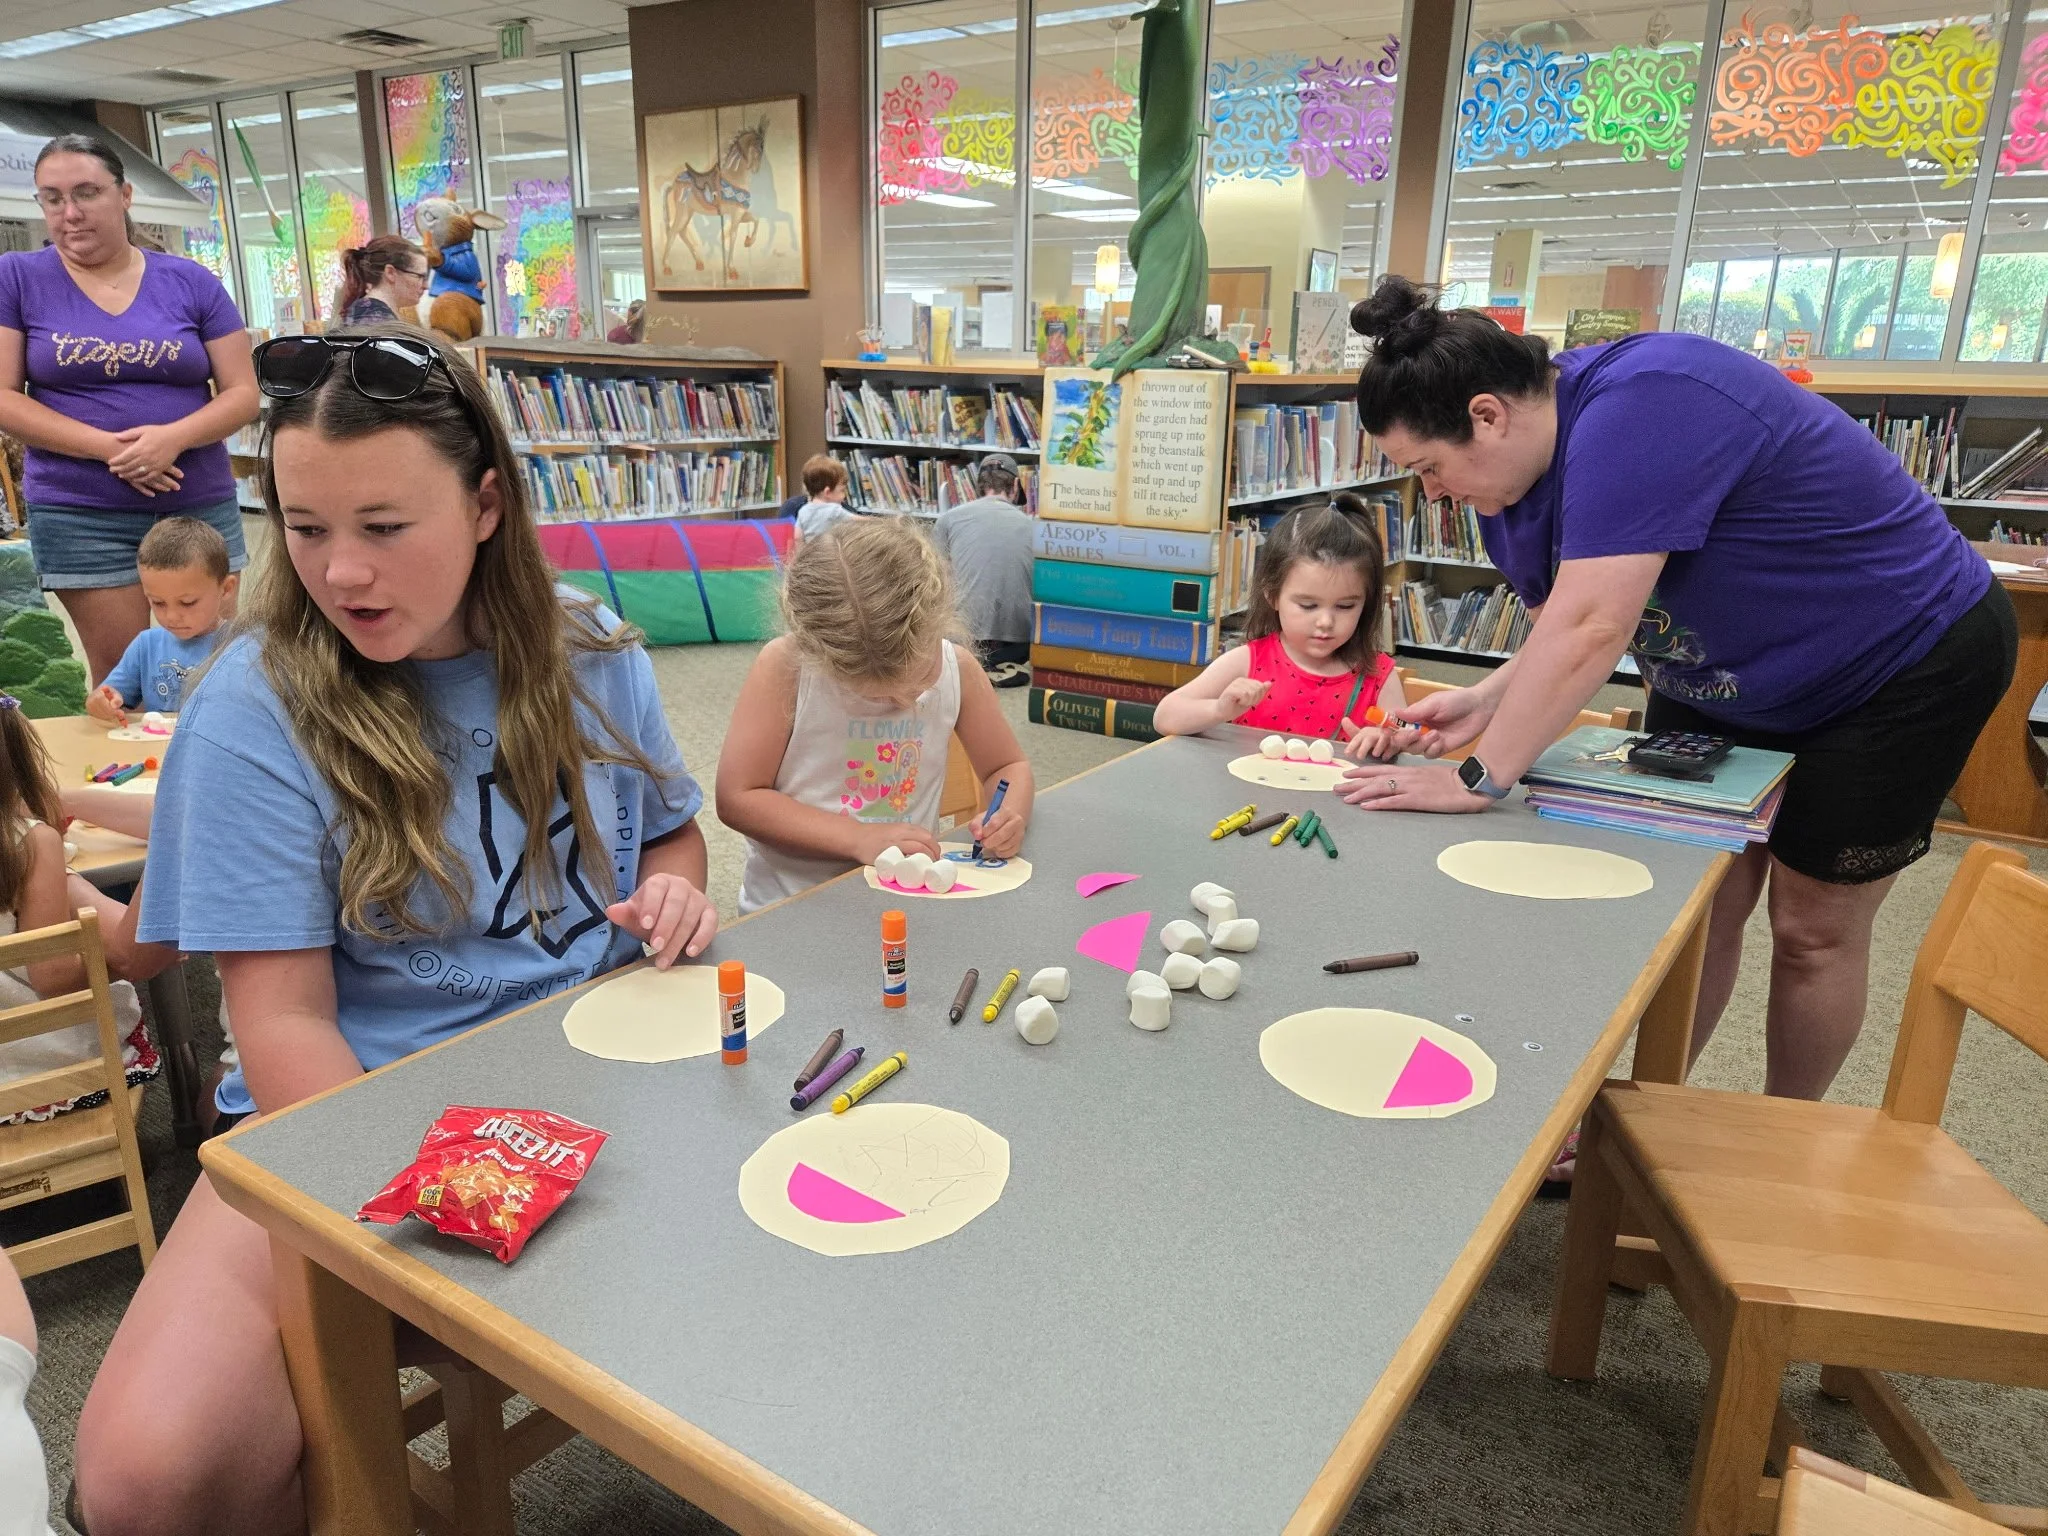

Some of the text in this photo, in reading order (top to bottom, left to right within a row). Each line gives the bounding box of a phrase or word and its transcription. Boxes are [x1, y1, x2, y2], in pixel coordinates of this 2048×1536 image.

[502, 26, 524, 59] EXIT
[1141, 381, 1208, 393] thrown out of
[1133, 397, 1212, 410] the window into
[1135, 412, 1207, 426] the garden had
[1134, 430, 1206, 442] sprung up into
[1132, 444, 1206, 457] a big beanstalk
[1132, 459, 1204, 475] which went up
[1132, 474, 1200, 489] and up and up
[1074, 485, 1100, 497] beans
[1103, 487, 1118, 498] his
[1133, 489, 1197, 503] till it reached
[1059, 499, 1111, 512] mother had
[1146, 505, 1161, 516] the
[1040, 523, 1107, 544] AESOP'S
[1044, 540, 1104, 561] FABLES
[1158, 544, 1186, 558] VOL.
[1089, 652, 1132, 668] Anne of
[1075, 661, 1145, 681] Green Gables
[1047, 672, 1143, 698] CHARLOTTE'S
[1053, 699, 1101, 720] OLIVER
[848, 719, 924, 739] FLOWER
[1056, 713, 1097, 732] TWIST
[408, 950, 596, 1009] ORIENT
